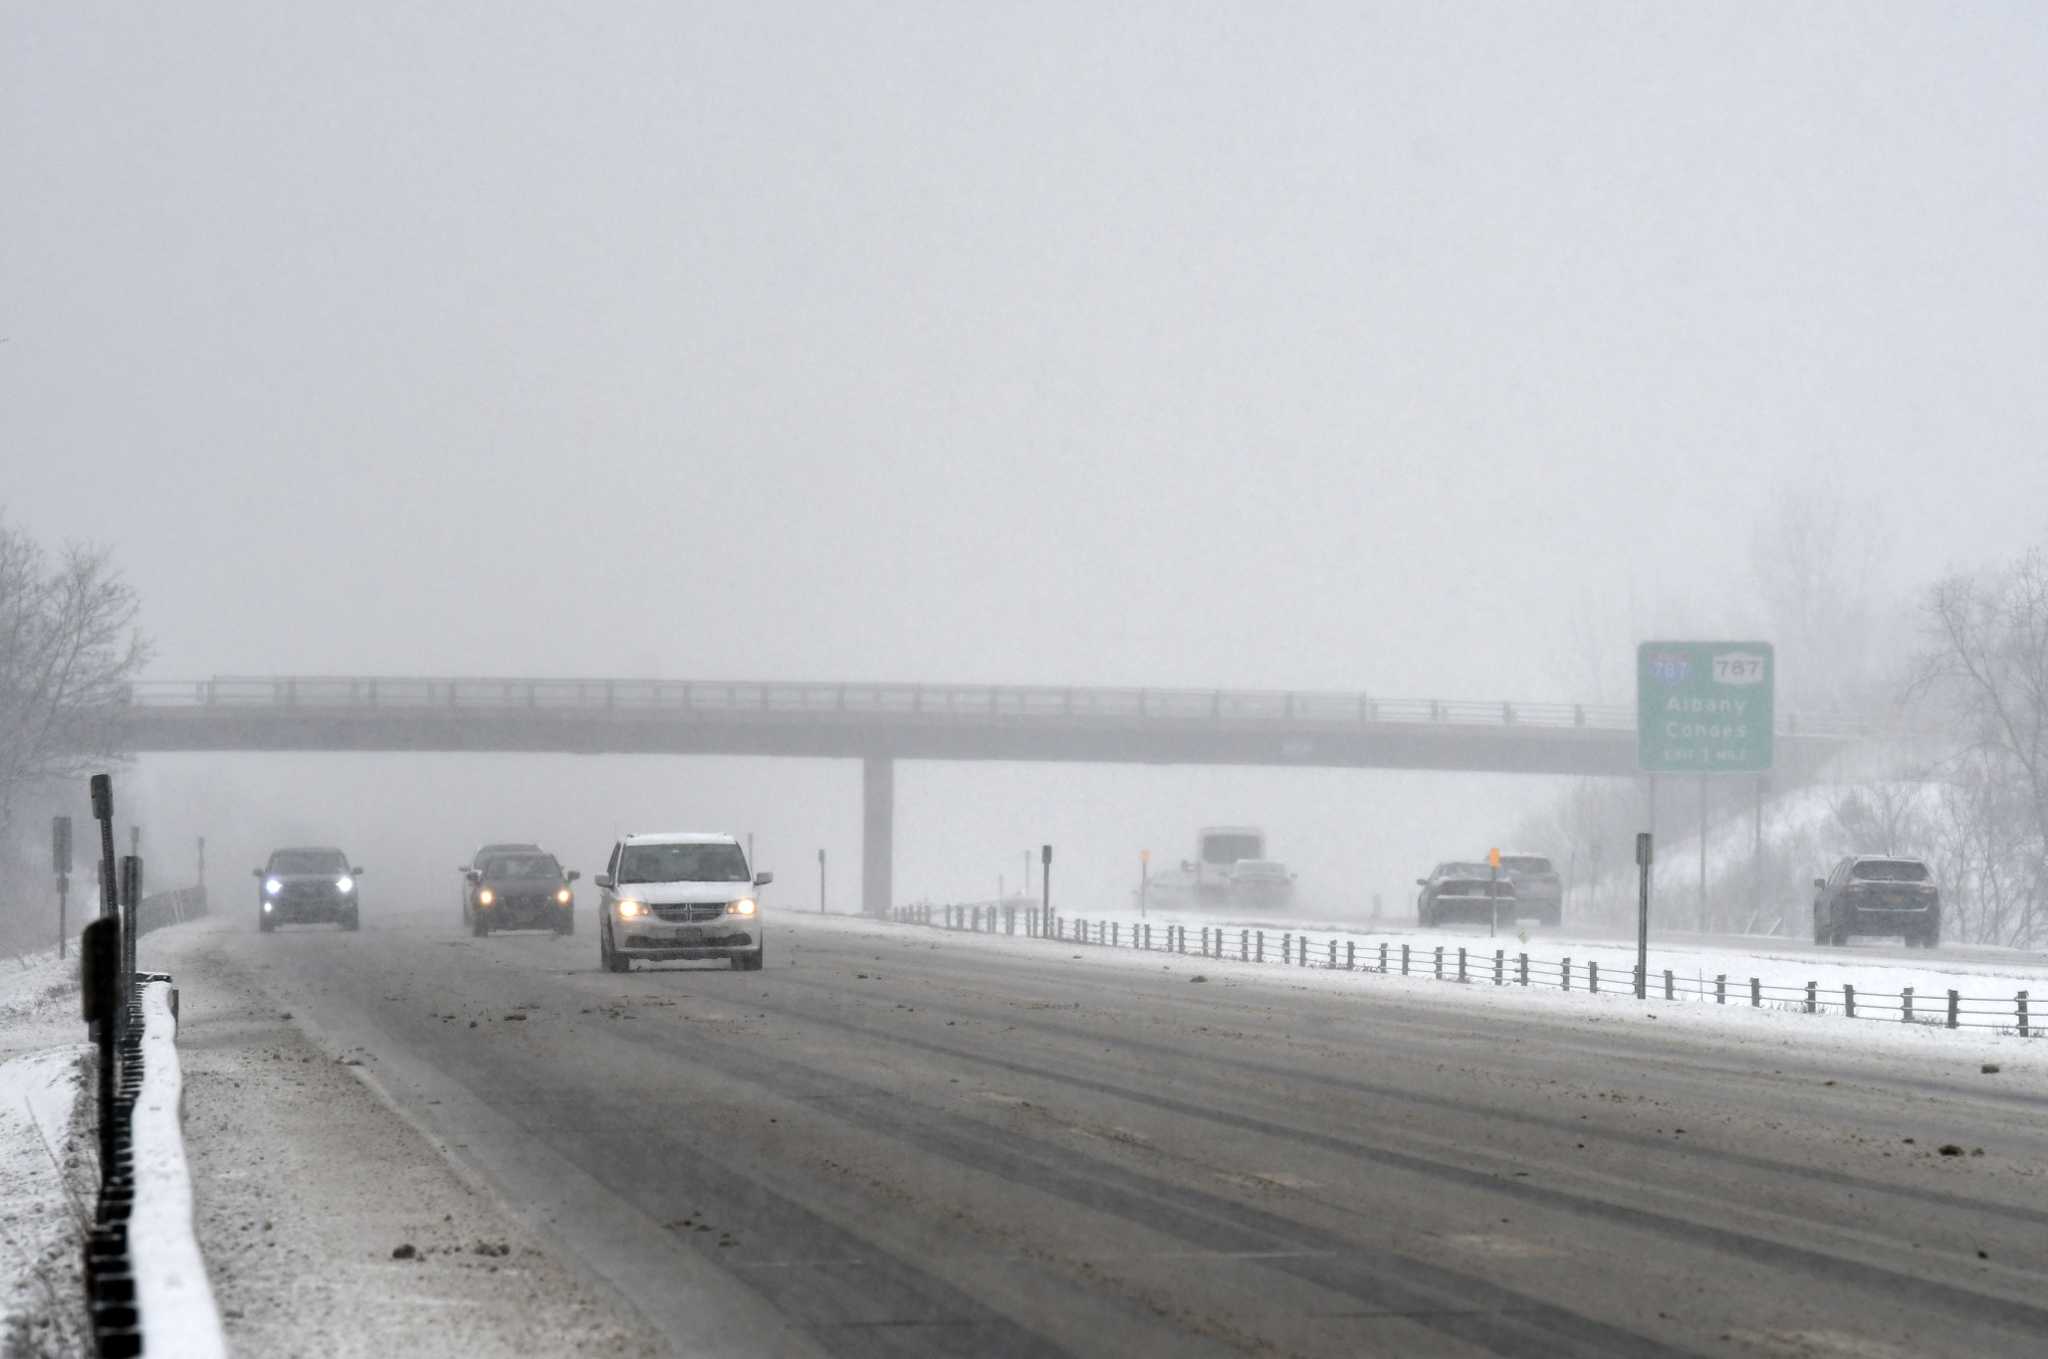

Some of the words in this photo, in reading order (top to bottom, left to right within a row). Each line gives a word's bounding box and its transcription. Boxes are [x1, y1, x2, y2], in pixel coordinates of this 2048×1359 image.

[1715, 660, 1760, 677] 787
[1665, 696, 1747, 717] Albany
[1665, 721, 1747, 738] Cohoes
